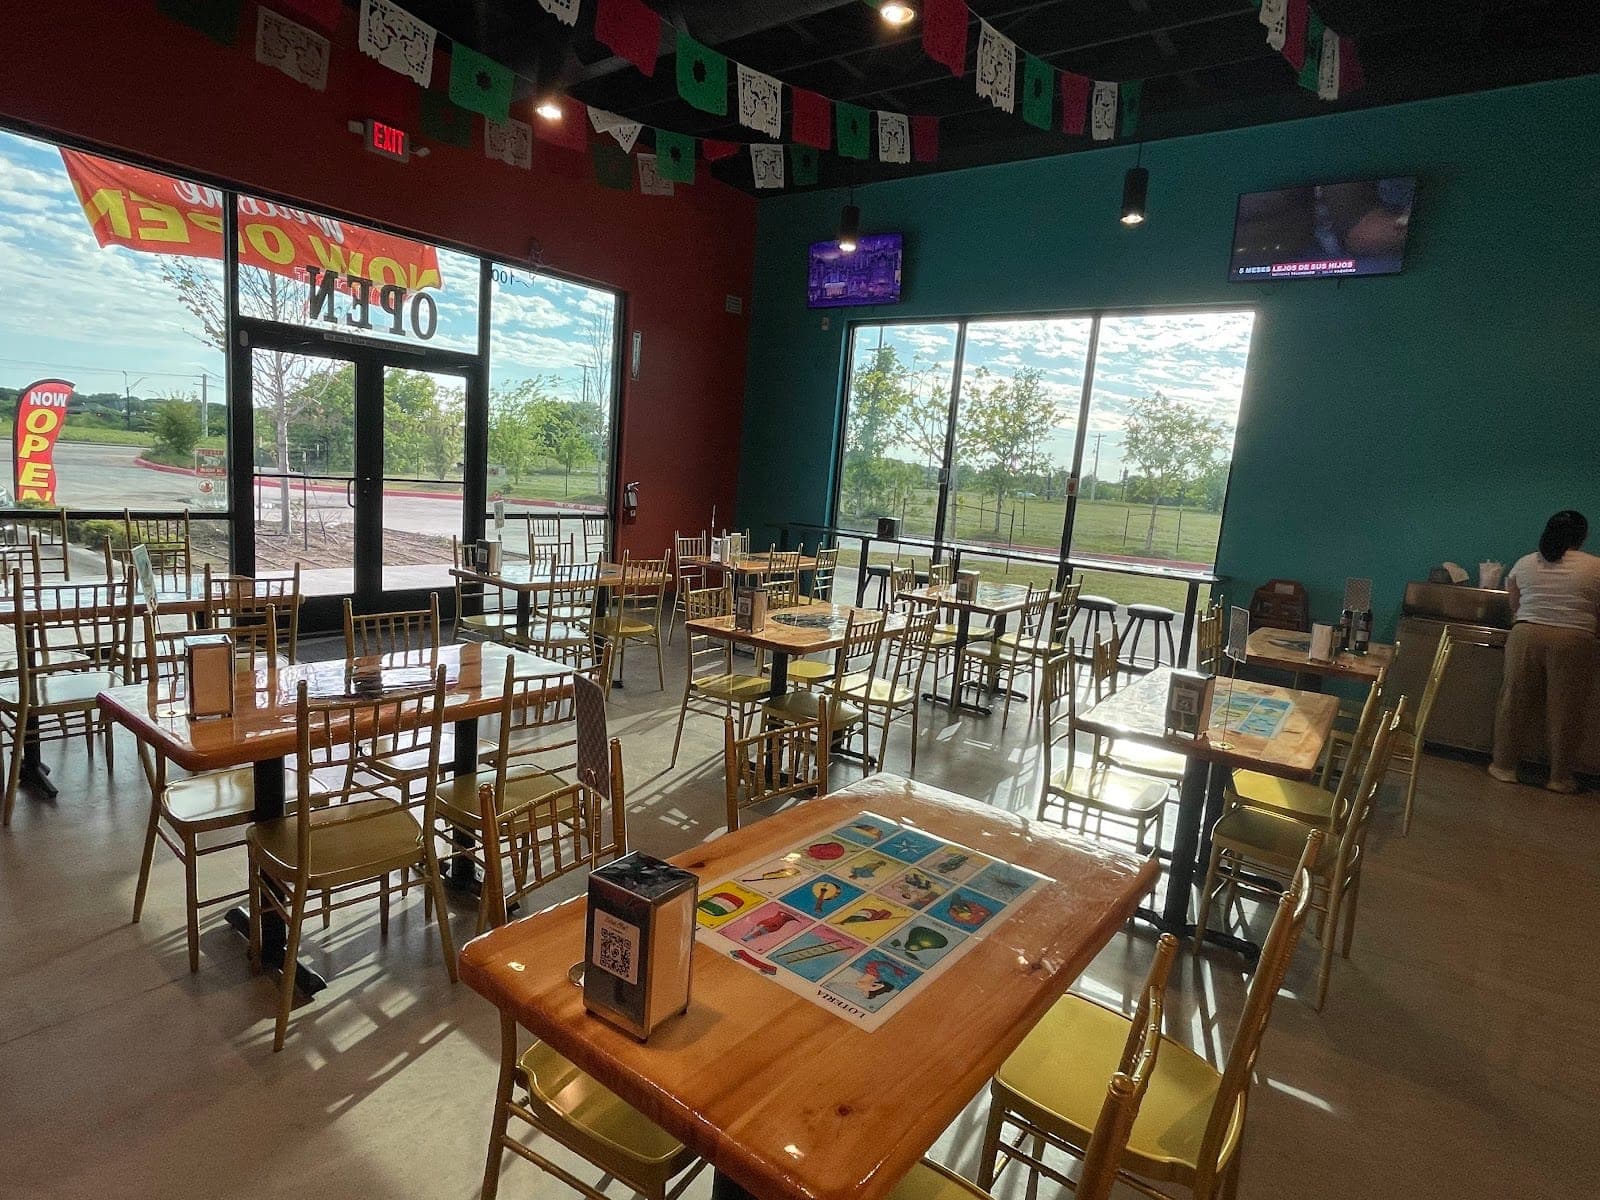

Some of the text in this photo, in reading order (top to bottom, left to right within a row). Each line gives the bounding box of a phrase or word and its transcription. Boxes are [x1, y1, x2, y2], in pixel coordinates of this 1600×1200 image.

[373, 121, 404, 155] EXIT
[1272, 264, 1297, 272] LEJOS
[1328, 261, 1353, 269] HIJOS
[29, 391, 68, 407] NOW
